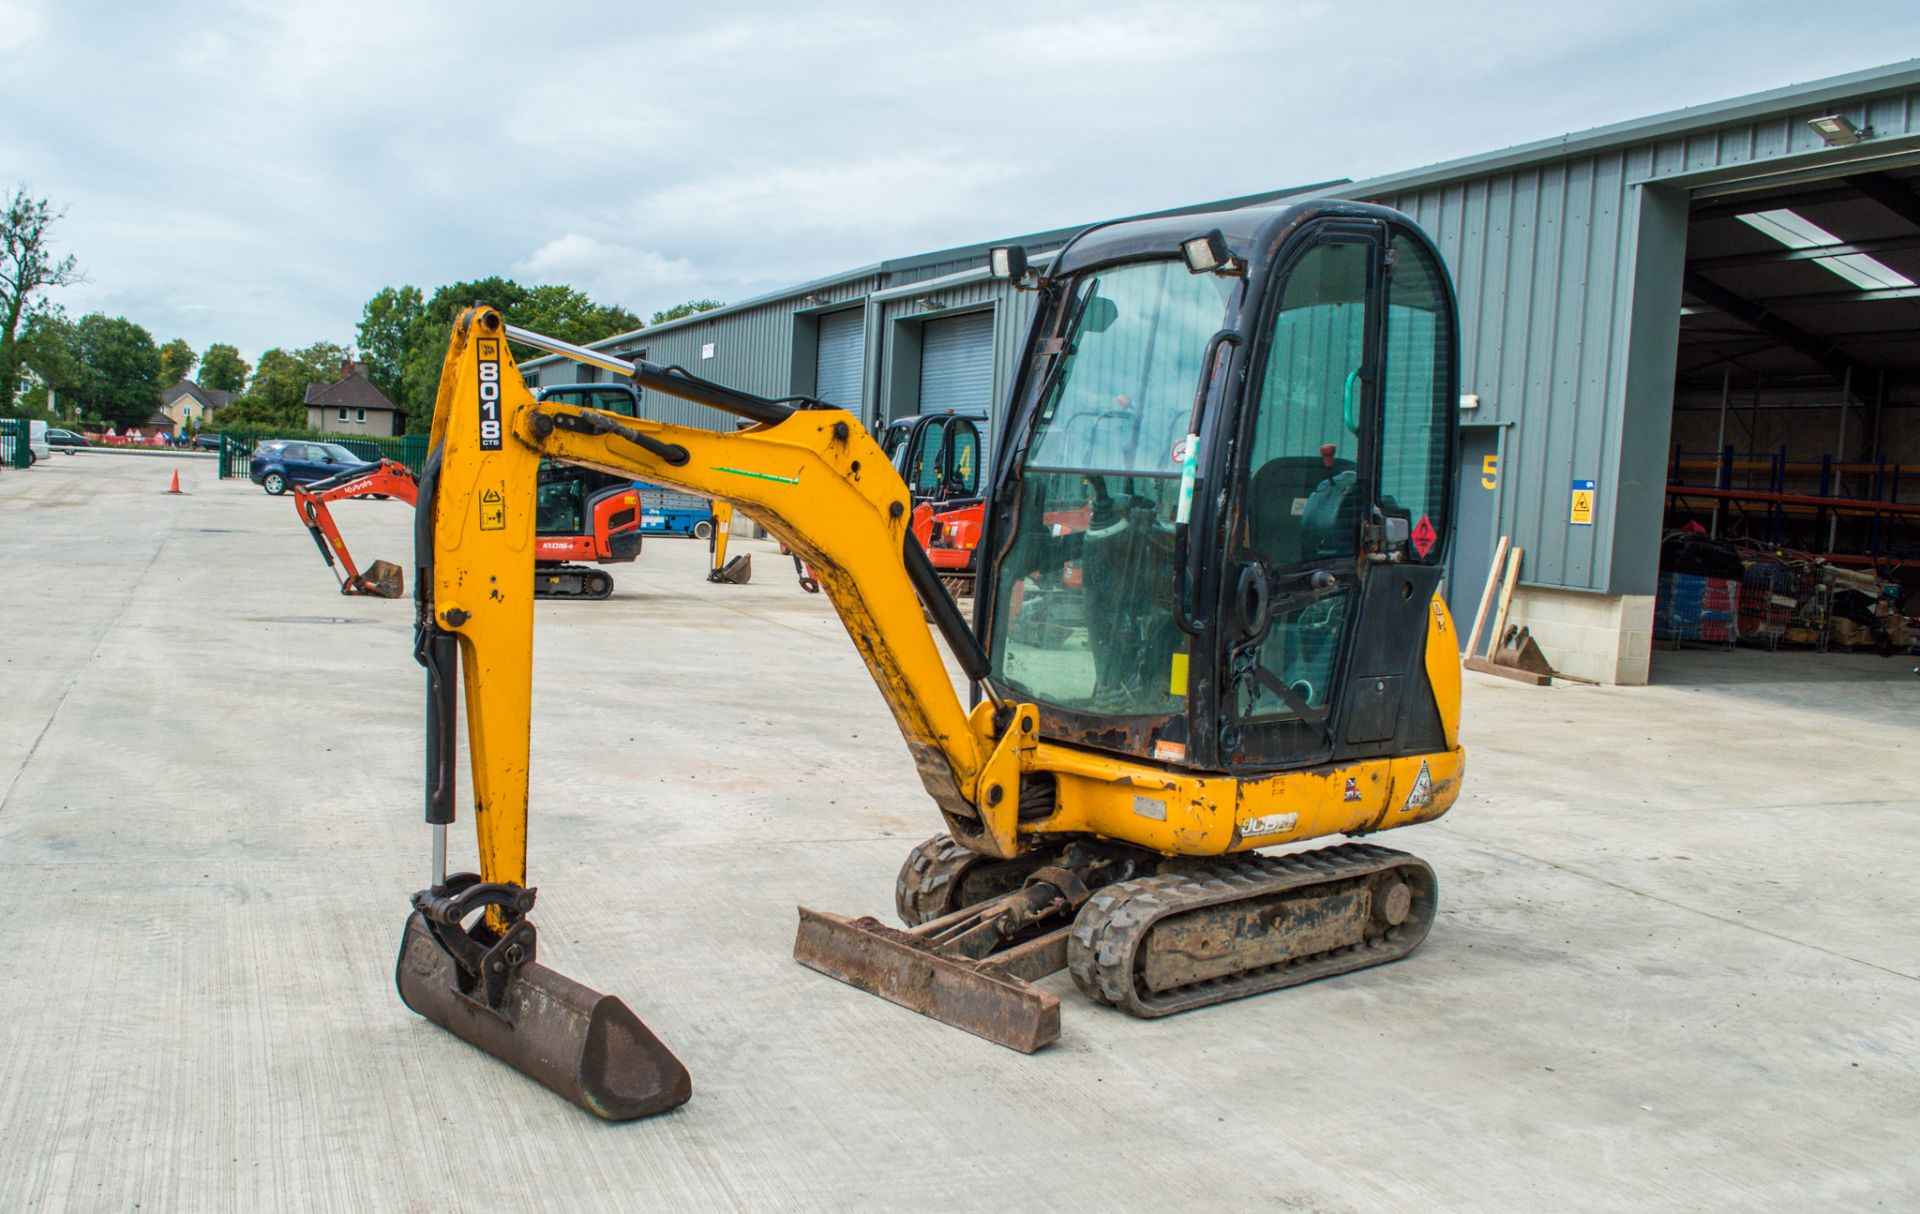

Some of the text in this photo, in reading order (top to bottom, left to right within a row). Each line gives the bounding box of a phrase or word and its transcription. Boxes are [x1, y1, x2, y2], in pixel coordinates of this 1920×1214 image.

[479, 362, 500, 439] 8018
[959, 445, 971, 481] 4
[1481, 455, 1498, 490] 5
[344, 479, 373, 494] Kubota
